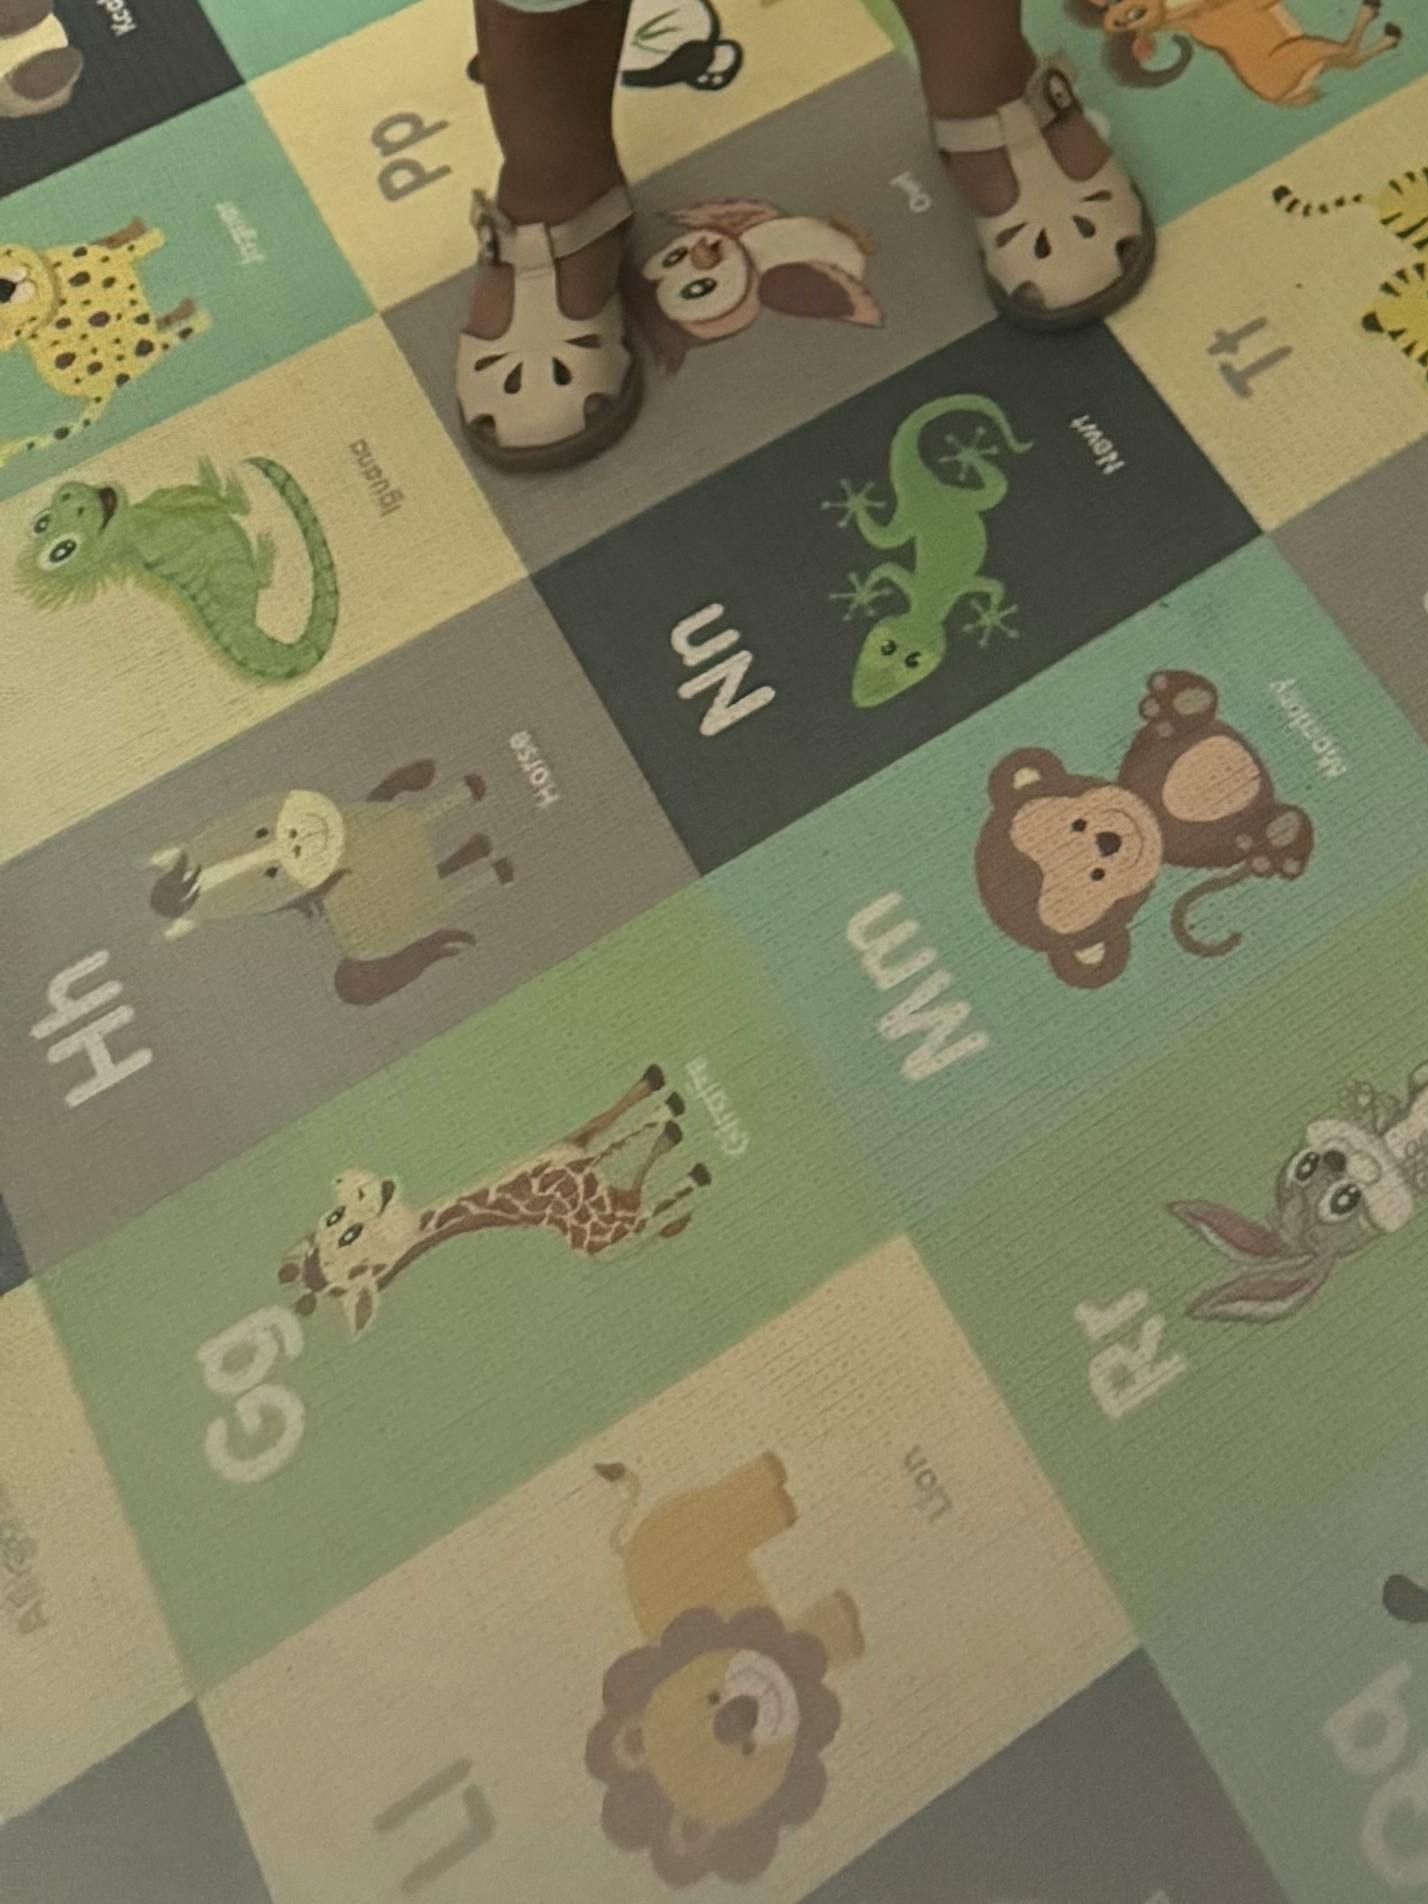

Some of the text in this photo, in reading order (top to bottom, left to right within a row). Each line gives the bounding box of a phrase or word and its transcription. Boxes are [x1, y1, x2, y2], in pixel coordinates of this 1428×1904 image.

[369, 112, 453, 202] Pp
[1206, 316, 1294, 397] Tt
[348, 438, 406, 518] Iguana
[1069, 412, 1125, 477] Newt
[670, 602, 776, 736] Nn
[508, 728, 559, 809] Horse
[1268, 676, 1349, 778] Monkey
[30, 950, 154, 1108] Hh
[844, 890, 990, 1083] Mm
[198, 1302, 305, 1485] Gg
[1074, 1285, 1187, 1419] Rr
[901, 1443, 954, 1523] Lion
